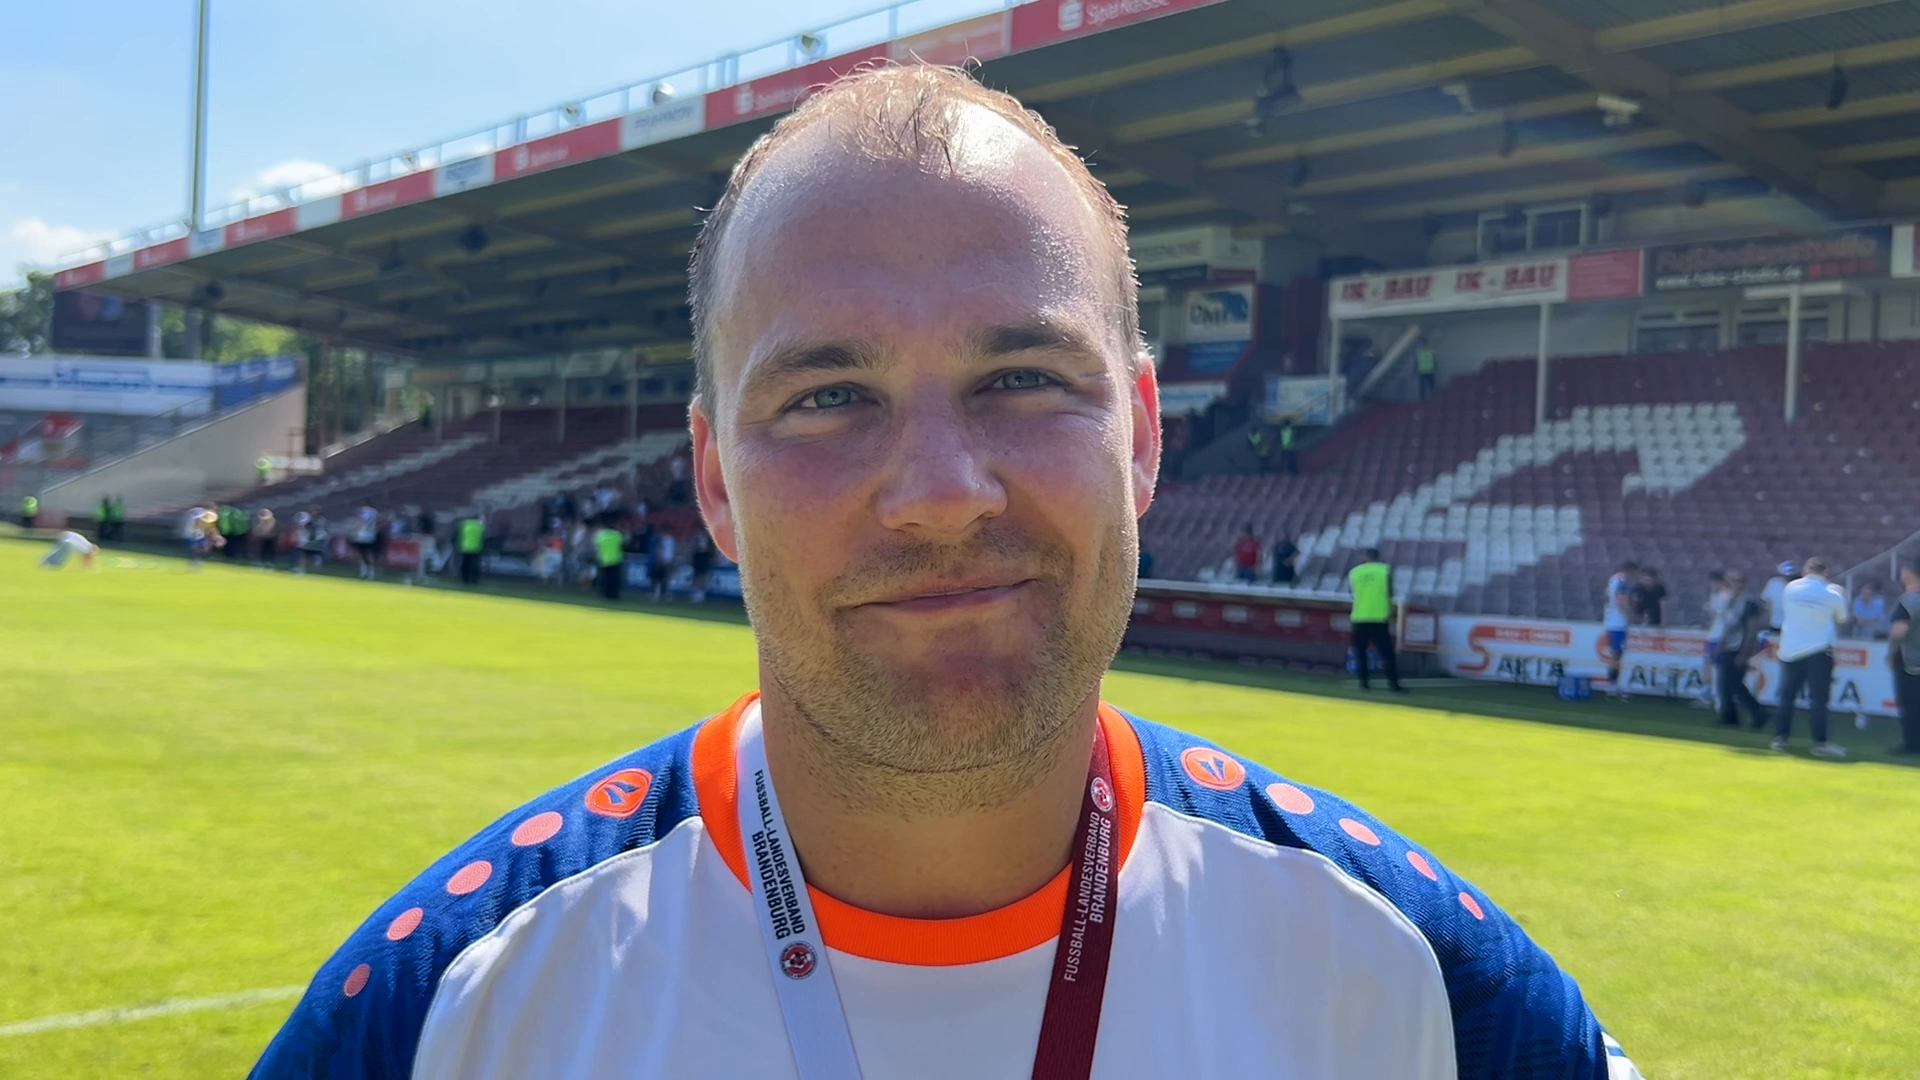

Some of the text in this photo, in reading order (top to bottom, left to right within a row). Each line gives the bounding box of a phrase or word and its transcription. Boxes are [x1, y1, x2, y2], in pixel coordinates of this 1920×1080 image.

[751, 829, 791, 941] BRANDENBURG
[754, 768, 806, 935] FUSSBALL-LANDESVERBAND
[1063, 811, 1101, 982] FUSSBALL-LANDESVERBAND
[1089, 816, 1112, 924] BRANDENBURG
